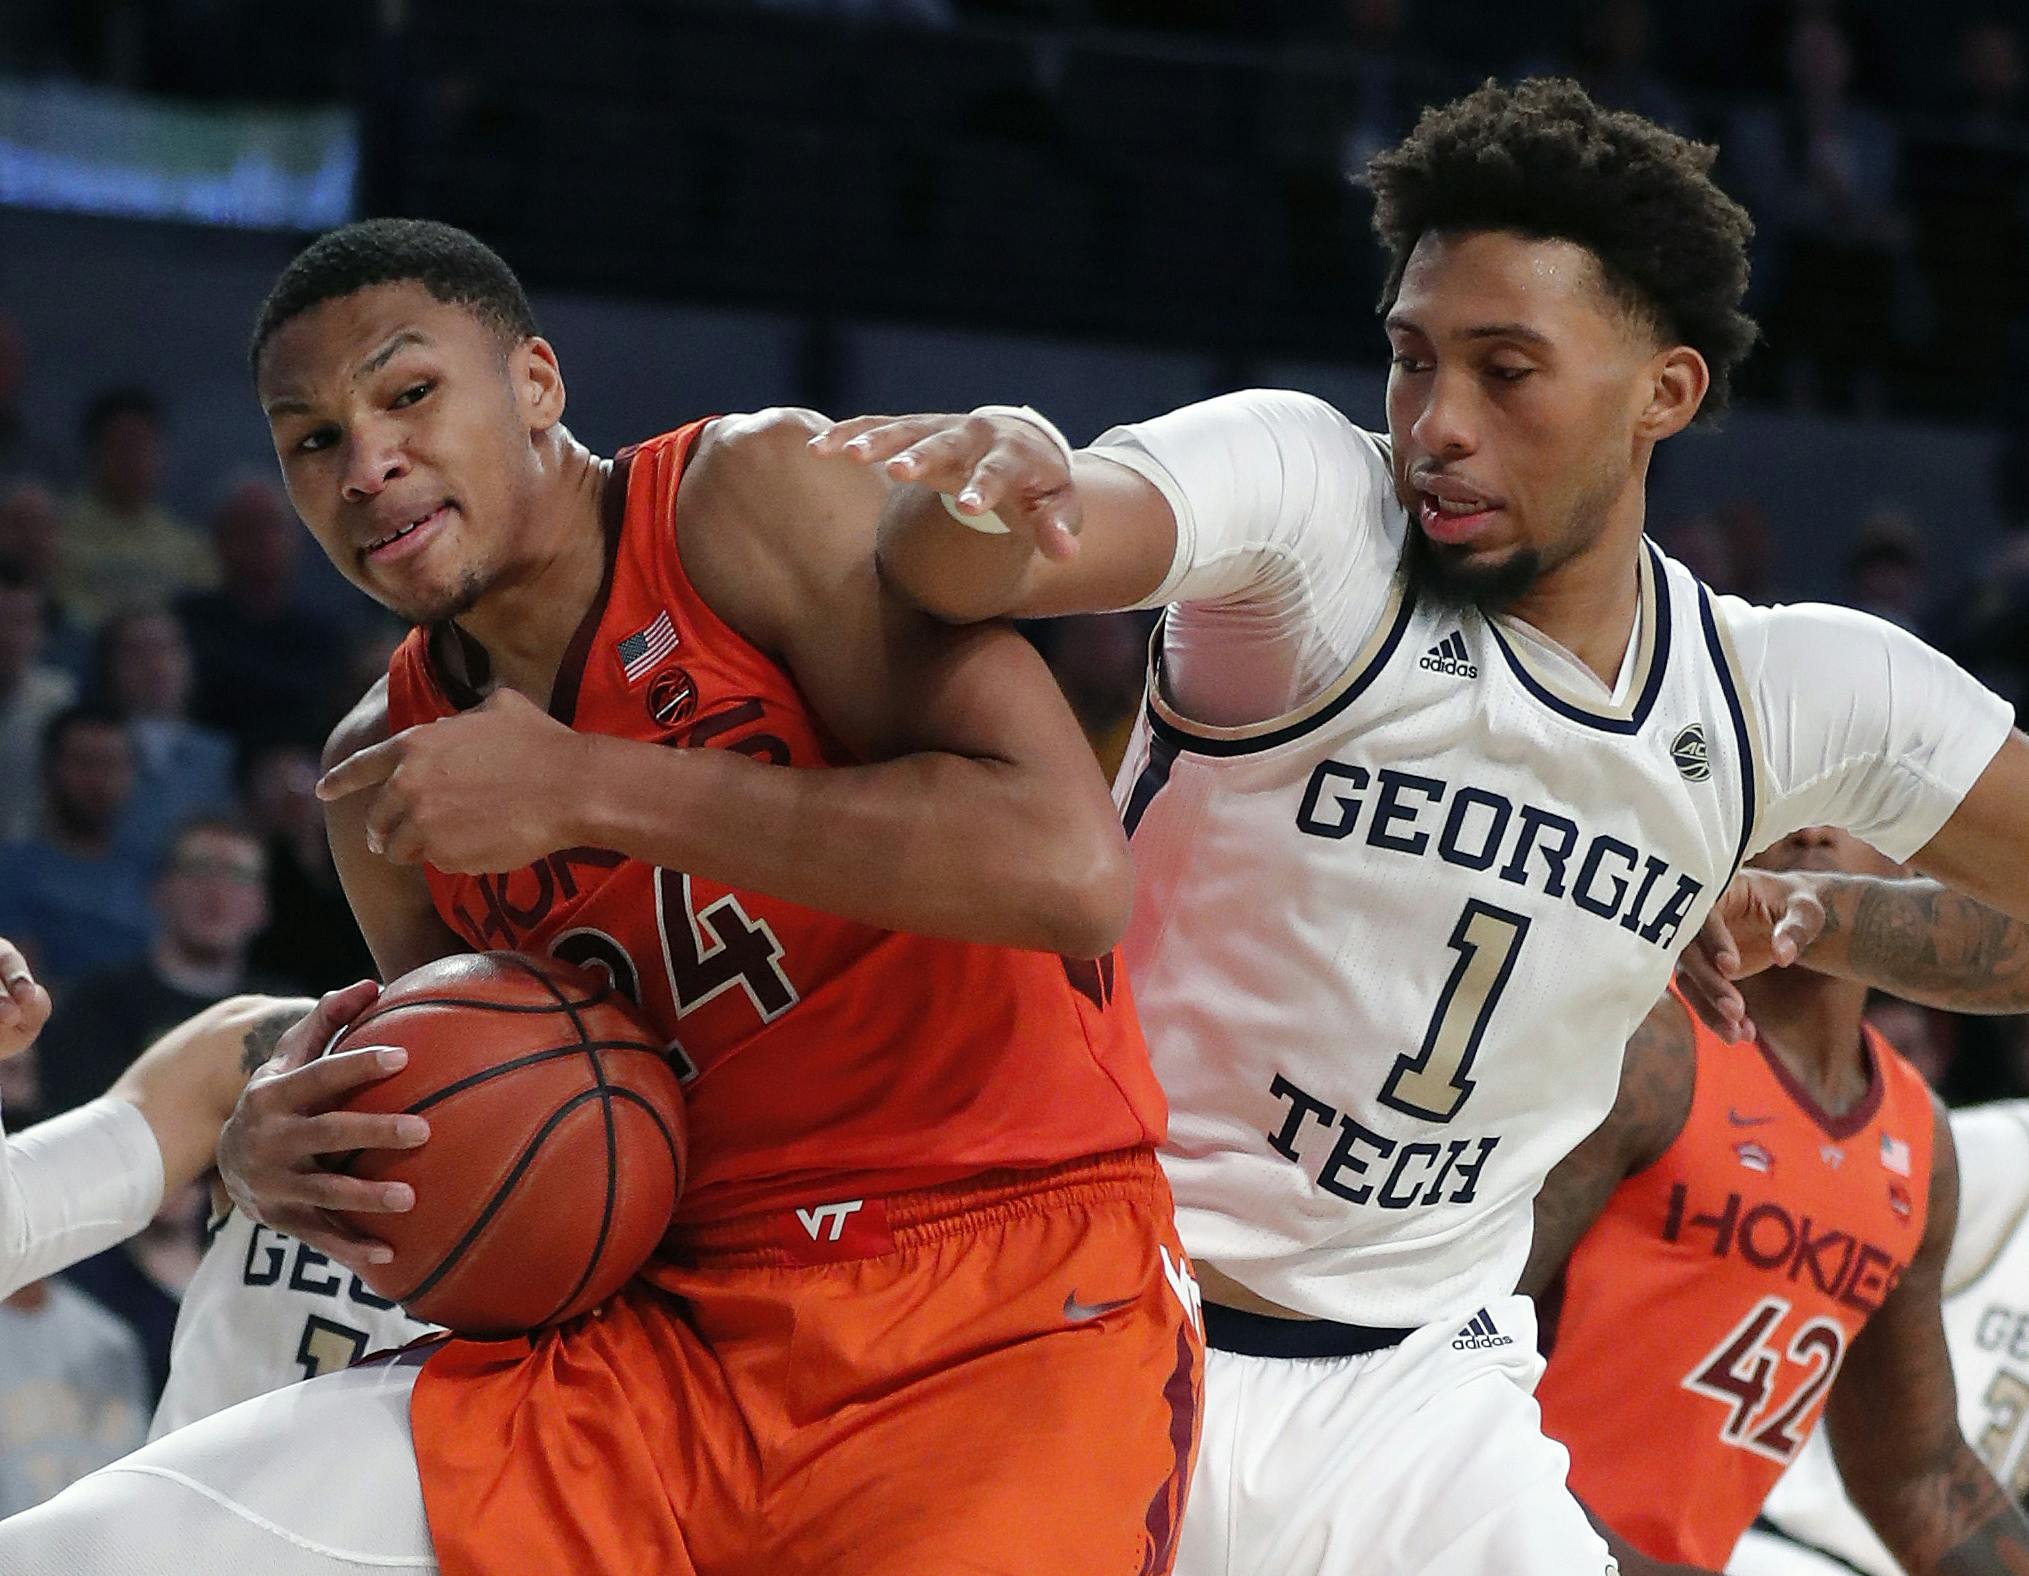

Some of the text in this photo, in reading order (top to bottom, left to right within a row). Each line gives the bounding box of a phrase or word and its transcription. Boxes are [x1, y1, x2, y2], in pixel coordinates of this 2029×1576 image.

[1419, 655, 1478, 679] adidas
[1296, 759, 1704, 950] GEORGIA
[1377, 897, 1532, 1123] 1
[1267, 1072, 1502, 1209] TECH
[796, 1200, 863, 1241] VT
[1451, 1334, 1514, 1350] adidas
[1681, 1296, 1845, 1465] 42
